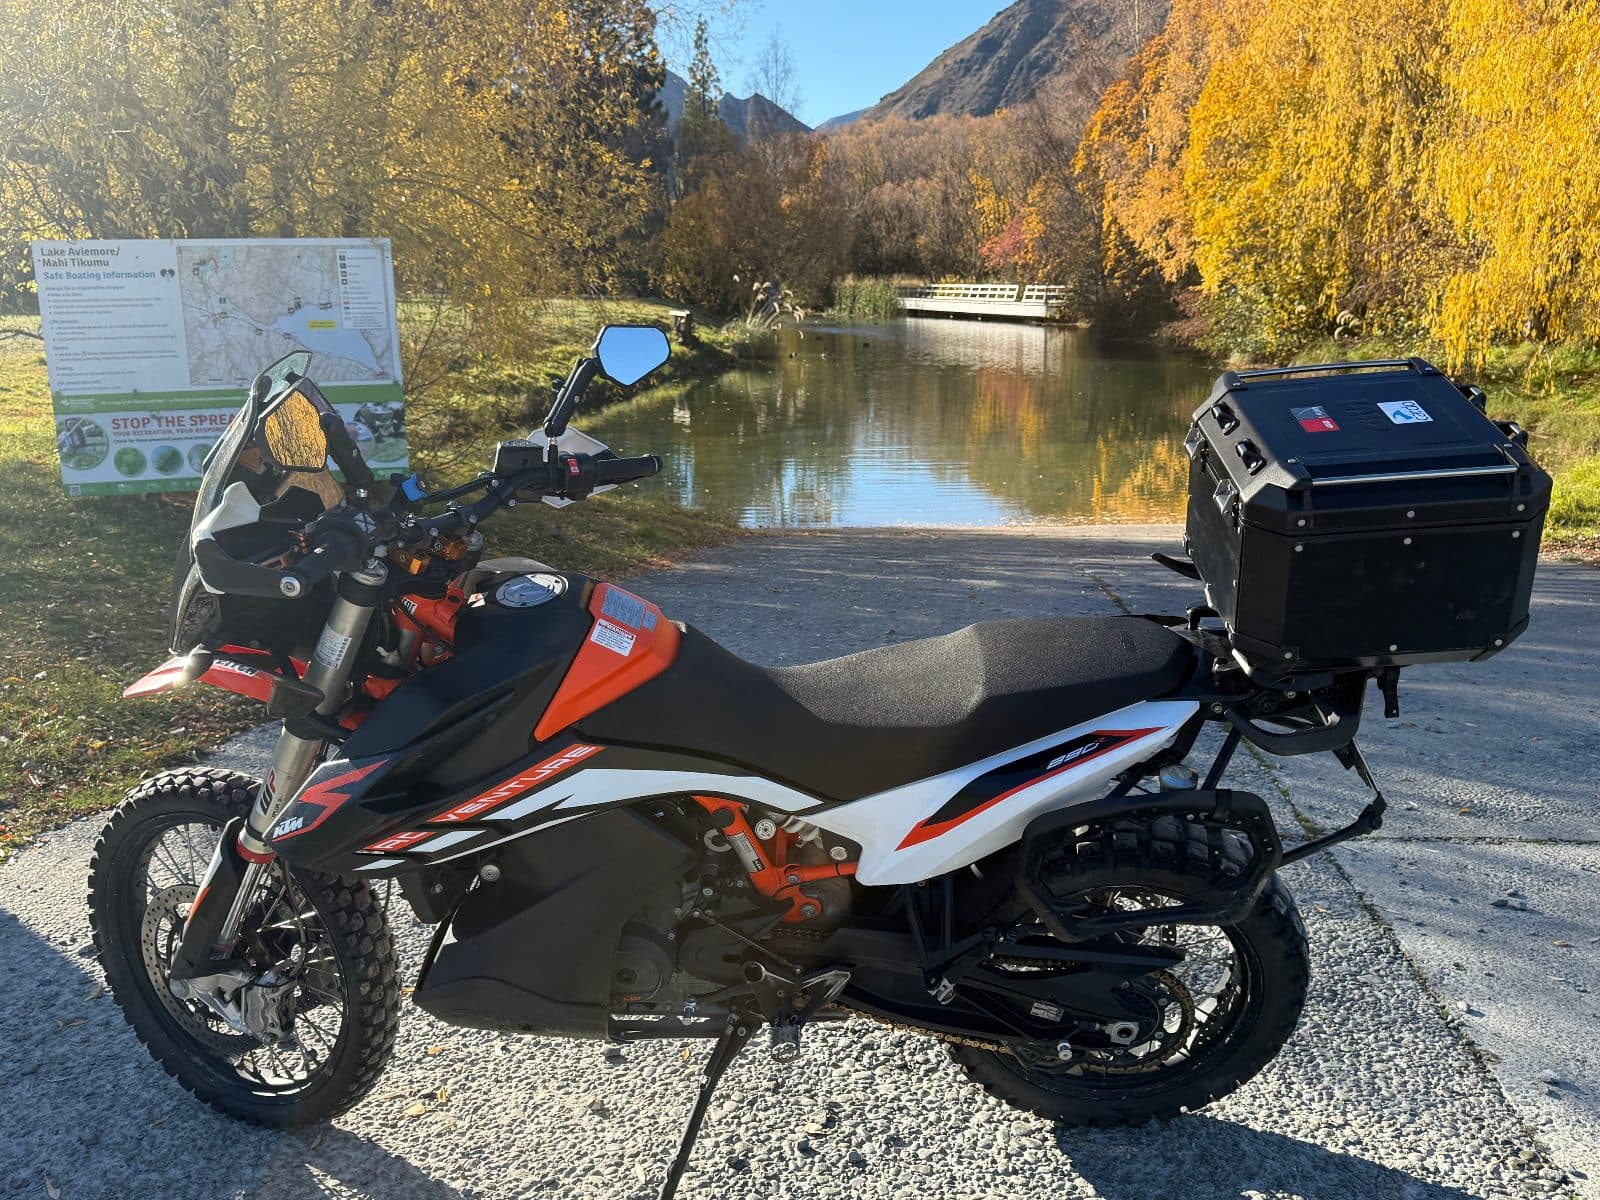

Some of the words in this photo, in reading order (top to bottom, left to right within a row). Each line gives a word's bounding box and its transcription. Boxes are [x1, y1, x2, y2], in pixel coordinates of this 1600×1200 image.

[40, 247, 65, 257] Lake
[68, 246, 121, 257] Aviemore/
[42, 258, 67, 268] Mahi
[69, 257, 110, 267] Tikumu
[43, 271, 64, 280] Safe
[65, 271, 101, 281] Boating
[102, 270, 156, 279] Information
[111, 416, 151, 430] STOP
[155, 415, 186, 428] THE
[189, 413, 238, 427] SPREA
[272, 816, 304, 838] KTM
